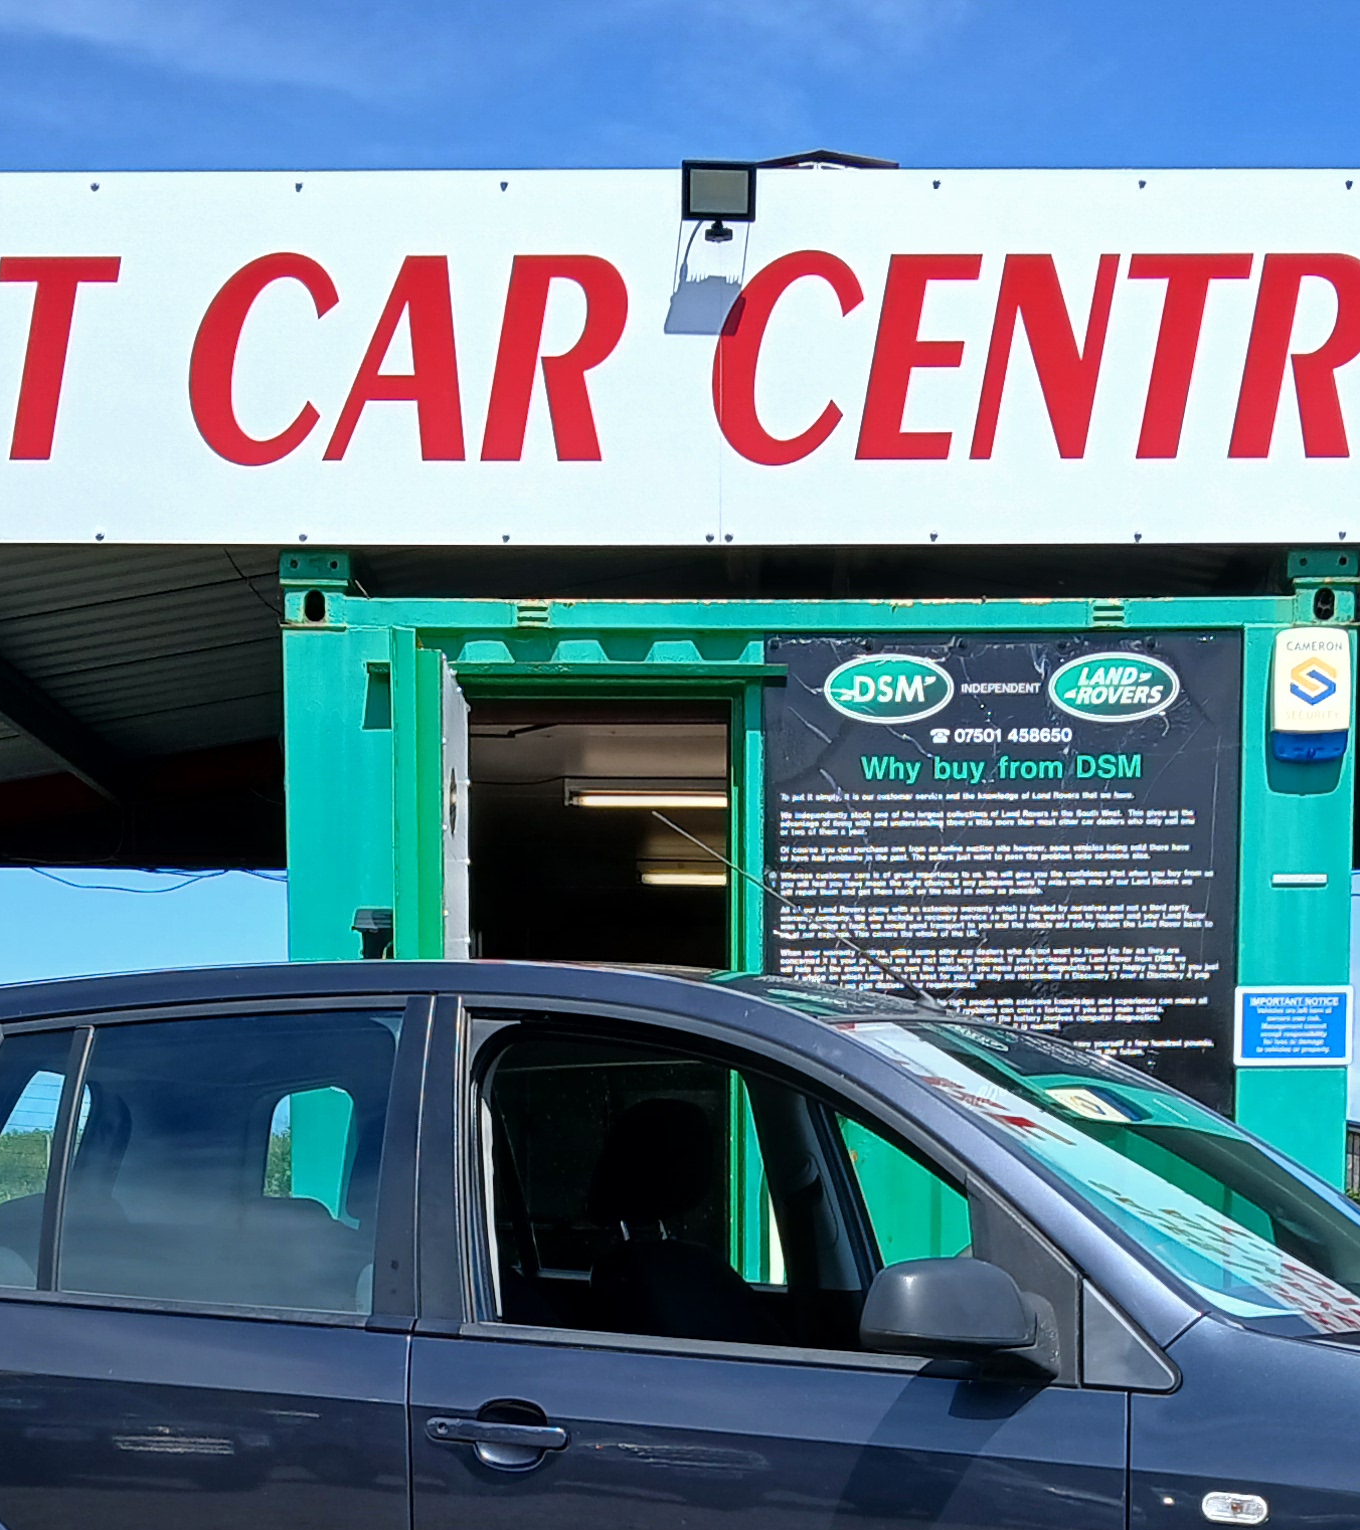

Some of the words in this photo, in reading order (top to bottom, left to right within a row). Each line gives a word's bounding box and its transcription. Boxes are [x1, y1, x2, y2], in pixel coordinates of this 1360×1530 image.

[189, 251, 630, 467] CAR
[1286, 641, 1343, 652] CAMERON
[1078, 666, 1142, 686] LAND
[853, 675, 927, 704] DSM
[961, 683, 1041, 695] INDEPENDENT
[1074, 685, 1164, 705] ROVERS
[1285, 710, 1341, 721] SECURITY
[953, 728, 1003, 744] 07501
[1007, 728, 1074, 743] 458650
[861, 756, 922, 784] Why
[934, 756, 986, 783] buy
[999, 755, 1064, 779] from
[1077, 754, 1143, 779] DSM
[1249, 996, 1304, 1007] IMPORTANT
[1305, 996, 1340, 1007] NOTICE
